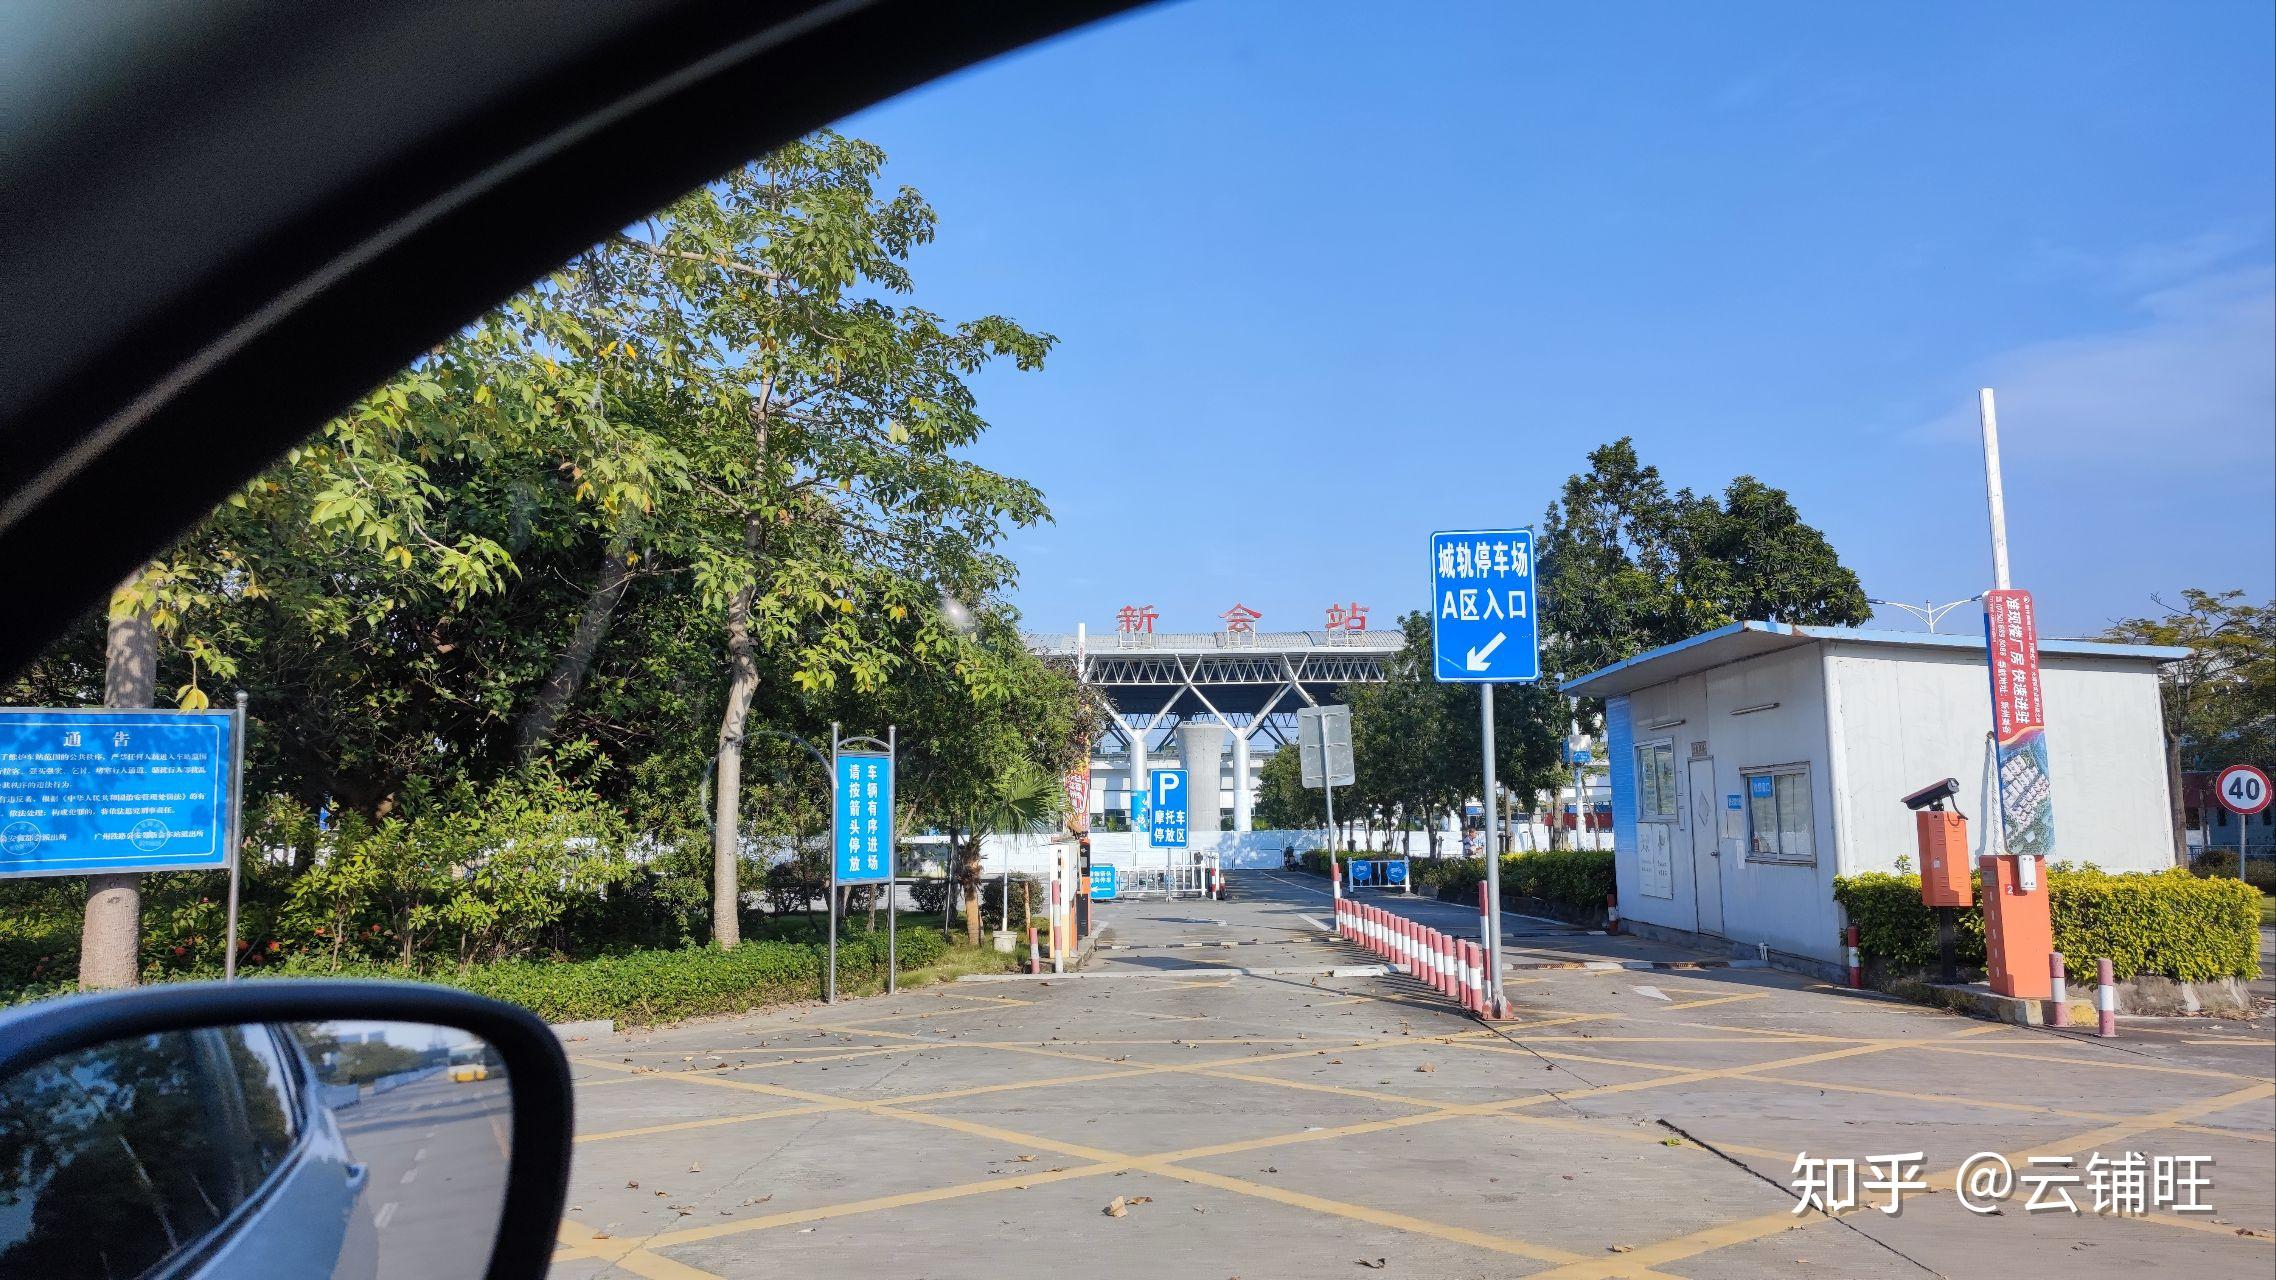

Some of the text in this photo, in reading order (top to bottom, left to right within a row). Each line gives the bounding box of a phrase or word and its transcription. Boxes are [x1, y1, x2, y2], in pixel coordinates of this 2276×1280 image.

[1438, 541, 1528, 579] 城轨停车场
[1116, 602, 1370, 634] 新会站
[1442, 588, 1526, 621] A区入口
[2012, 669, 2030, 724] 快速进驻
[63, 731, 131, 748] 通告
[1160, 773, 1180, 805] P
[2229, 777, 2260, 800] 40
[849, 764, 860, 872] 请按箭头停放
[867, 765, 878, 871] 车辆有序进场
[1154, 810, 1186, 825] 摩托车
[1154, 828, 1186, 842] 停放区
[2007, 885, 2014, 895] 2
